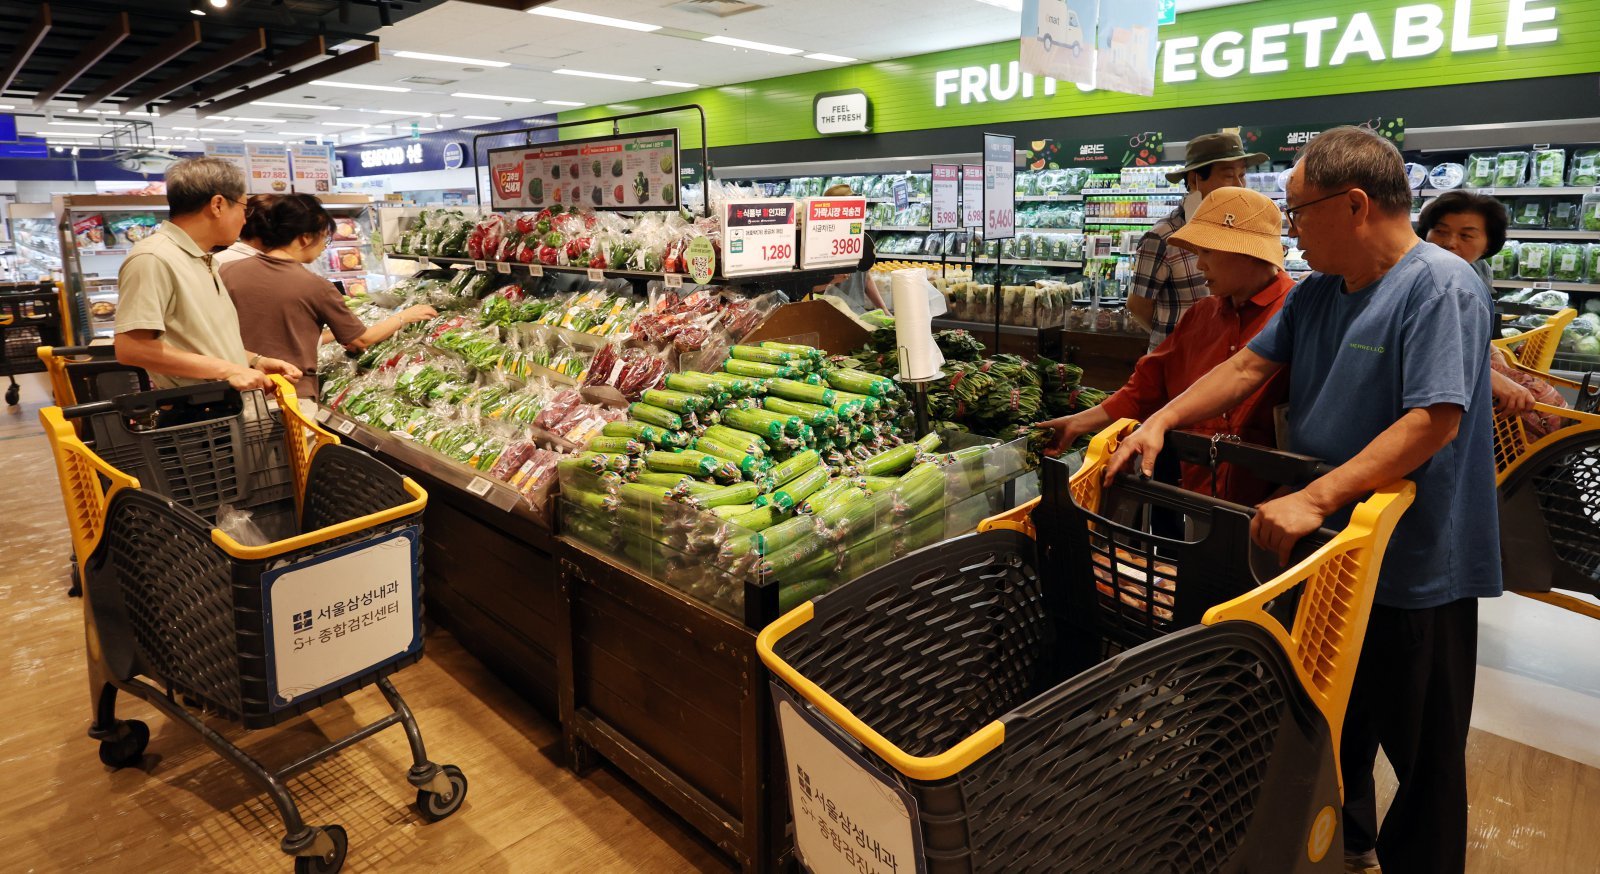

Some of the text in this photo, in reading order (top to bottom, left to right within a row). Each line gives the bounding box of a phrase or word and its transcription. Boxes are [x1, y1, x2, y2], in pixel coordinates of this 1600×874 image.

[1157, 0, 1559, 83] EGETABLE
[832, 104, 850, 113] FEEL
[821, 113, 862, 124] THE FRESH
[361, 146, 405, 168] SEAFOOD
[1080, 144, 1105, 155] 샐러드
[813, 207, 841, 218] 가락시장
[937, 211, 957, 223] 5,980
[989, 209, 1013, 229] 5,460
[1223, 212, 1238, 227] R
[762, 244, 792, 261] 1,280
[831, 238, 861, 256] 3980
[317, 580, 399, 620] 서울삼성내과
[318, 600, 399, 644] 종합검진센터
[815, 788, 898, 874] 서울삼성내과
